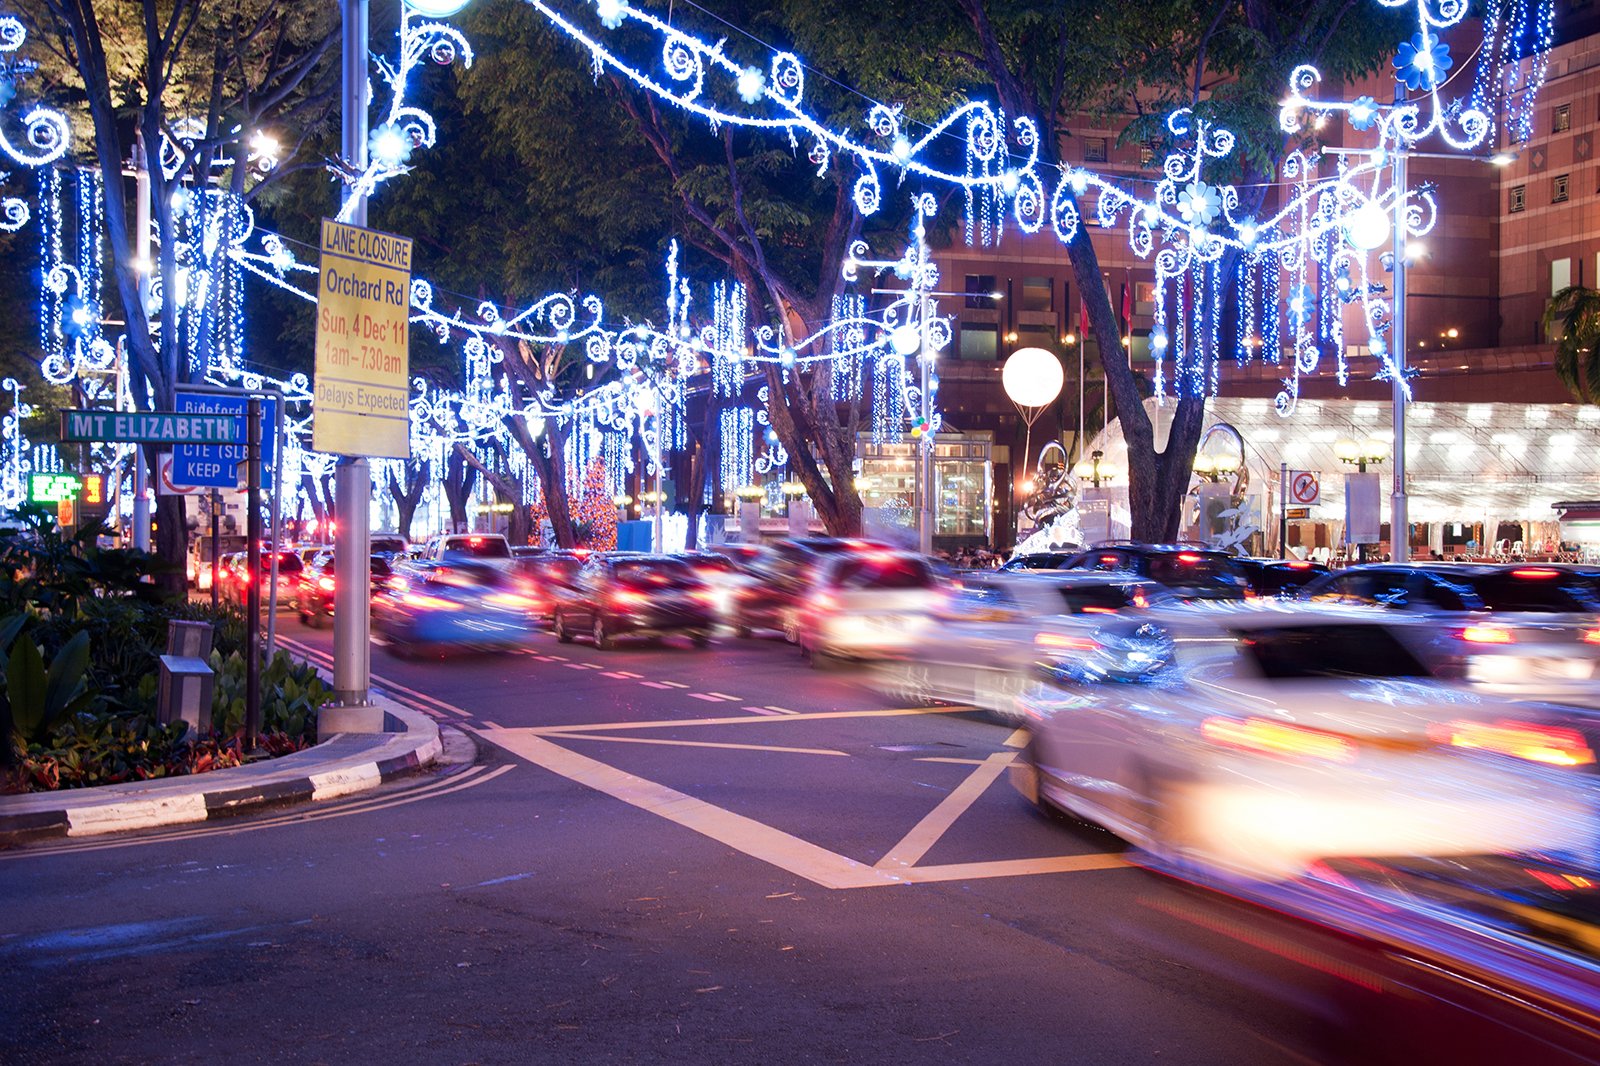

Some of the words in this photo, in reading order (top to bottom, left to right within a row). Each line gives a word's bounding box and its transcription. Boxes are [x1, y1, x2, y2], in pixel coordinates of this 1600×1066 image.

[326, 224, 355, 256] LANE
[358, 231, 408, 266] CLOSURE
[326, 268, 381, 301] Orchard
[386, 280, 403, 306] Rd
[321, 307, 349, 340] Sun,
[352, 313, 360, 336] 4
[185, 401, 242, 419] Bideford
[318, 383, 354, 409] Delays
[358, 387, 405, 412] Expected
[73, 415, 107, 437] MT
[115, 417, 230, 440] ELIZABETH
[183, 444, 210, 457] CTE
[187, 462, 221, 478] KEEP
